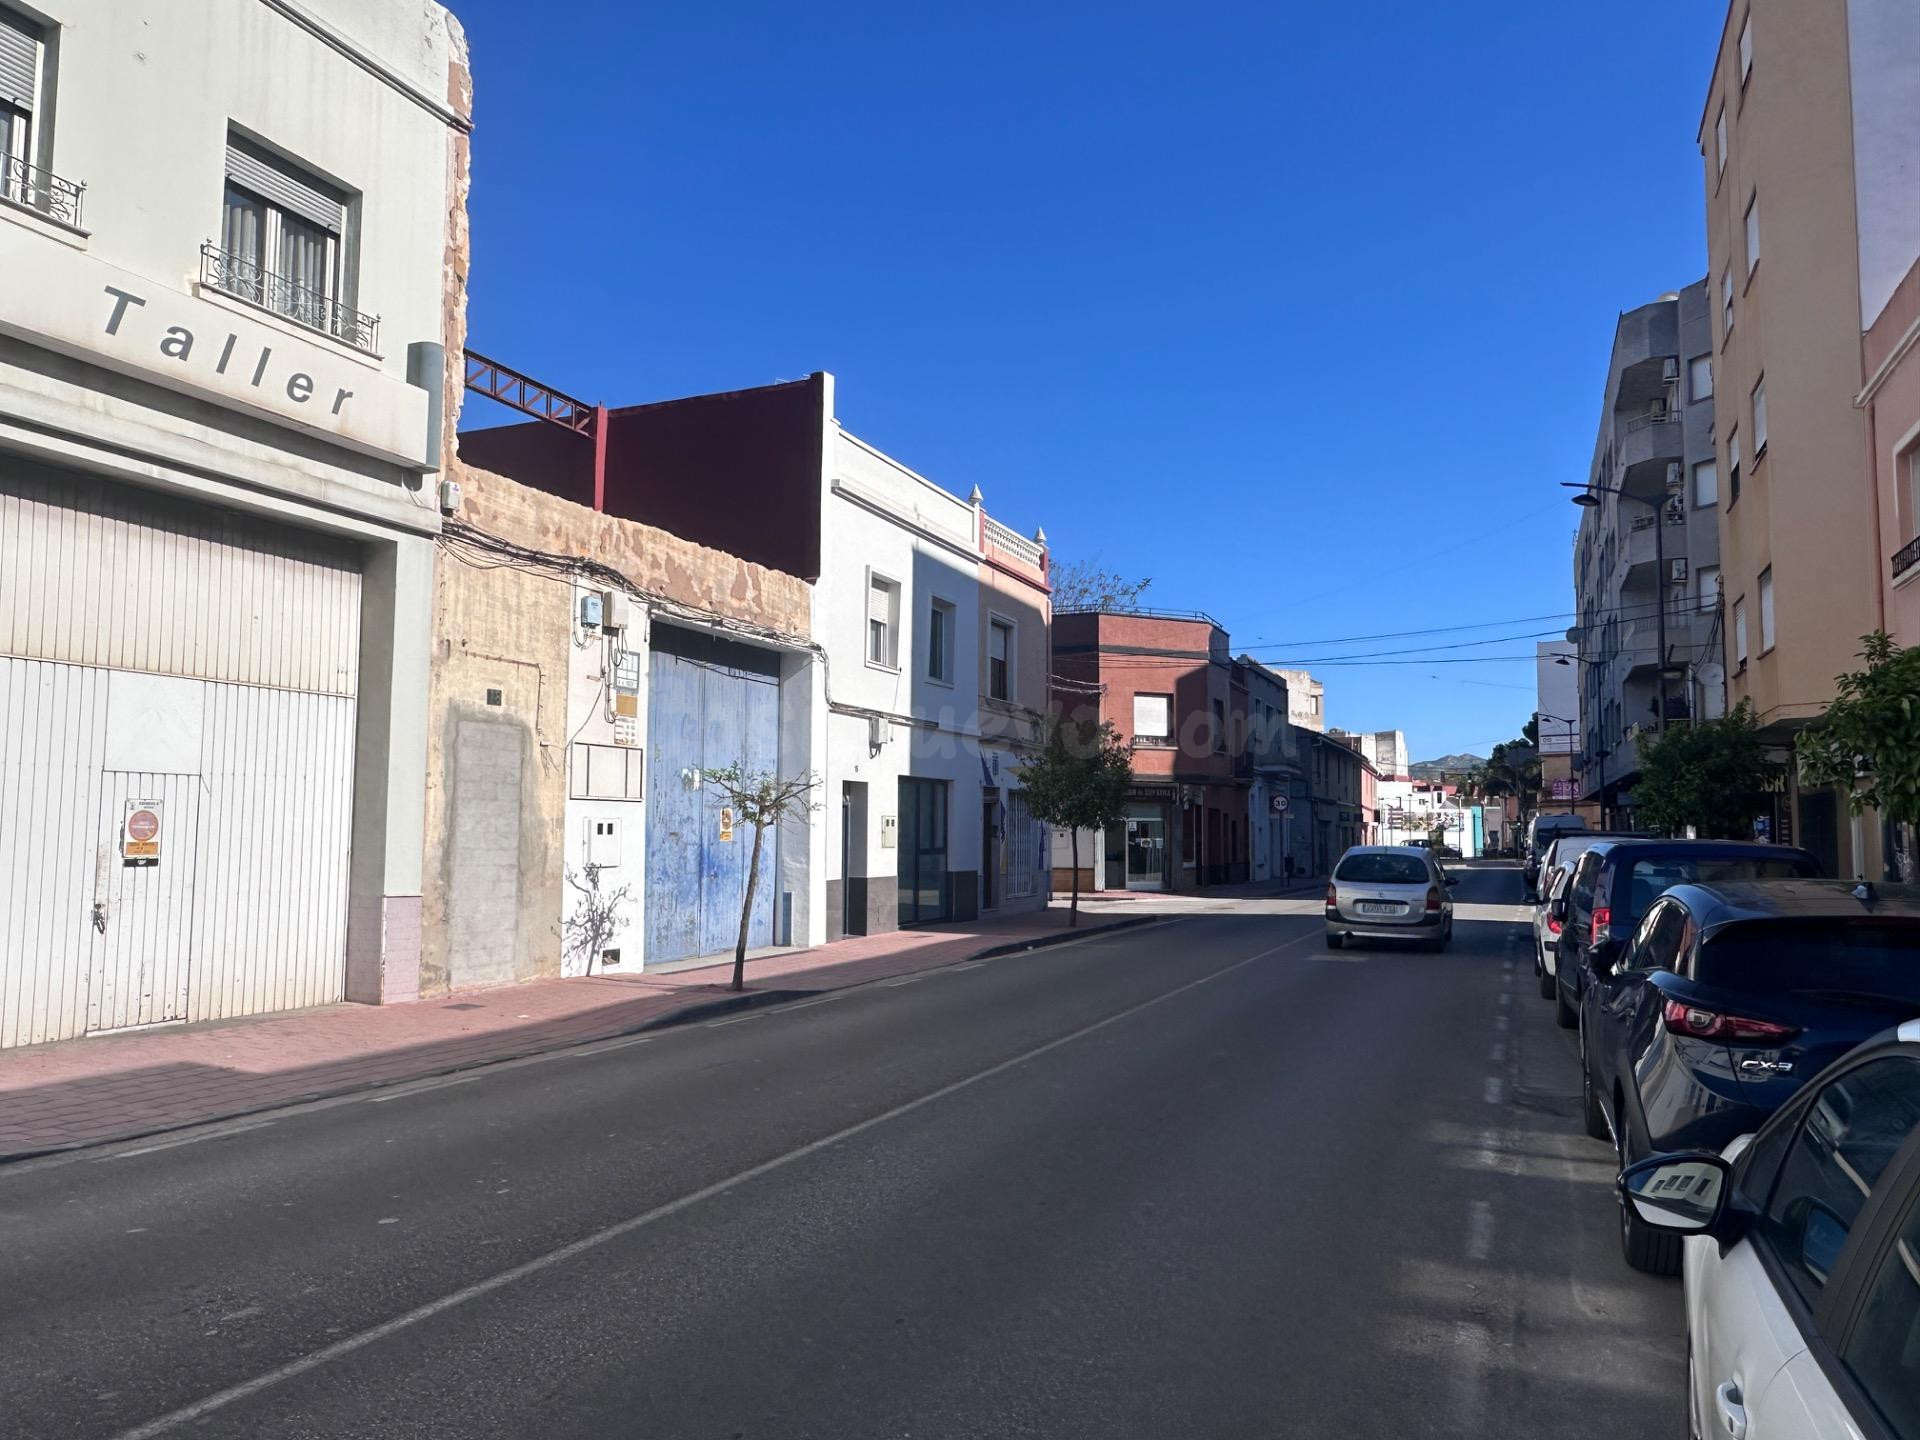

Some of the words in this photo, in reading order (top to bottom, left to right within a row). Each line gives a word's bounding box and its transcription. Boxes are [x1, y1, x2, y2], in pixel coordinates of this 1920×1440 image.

[103, 285, 354, 416] Taller
[1275, 799, 1287, 807] 30
[1741, 1060, 1793, 1072] CX-3
